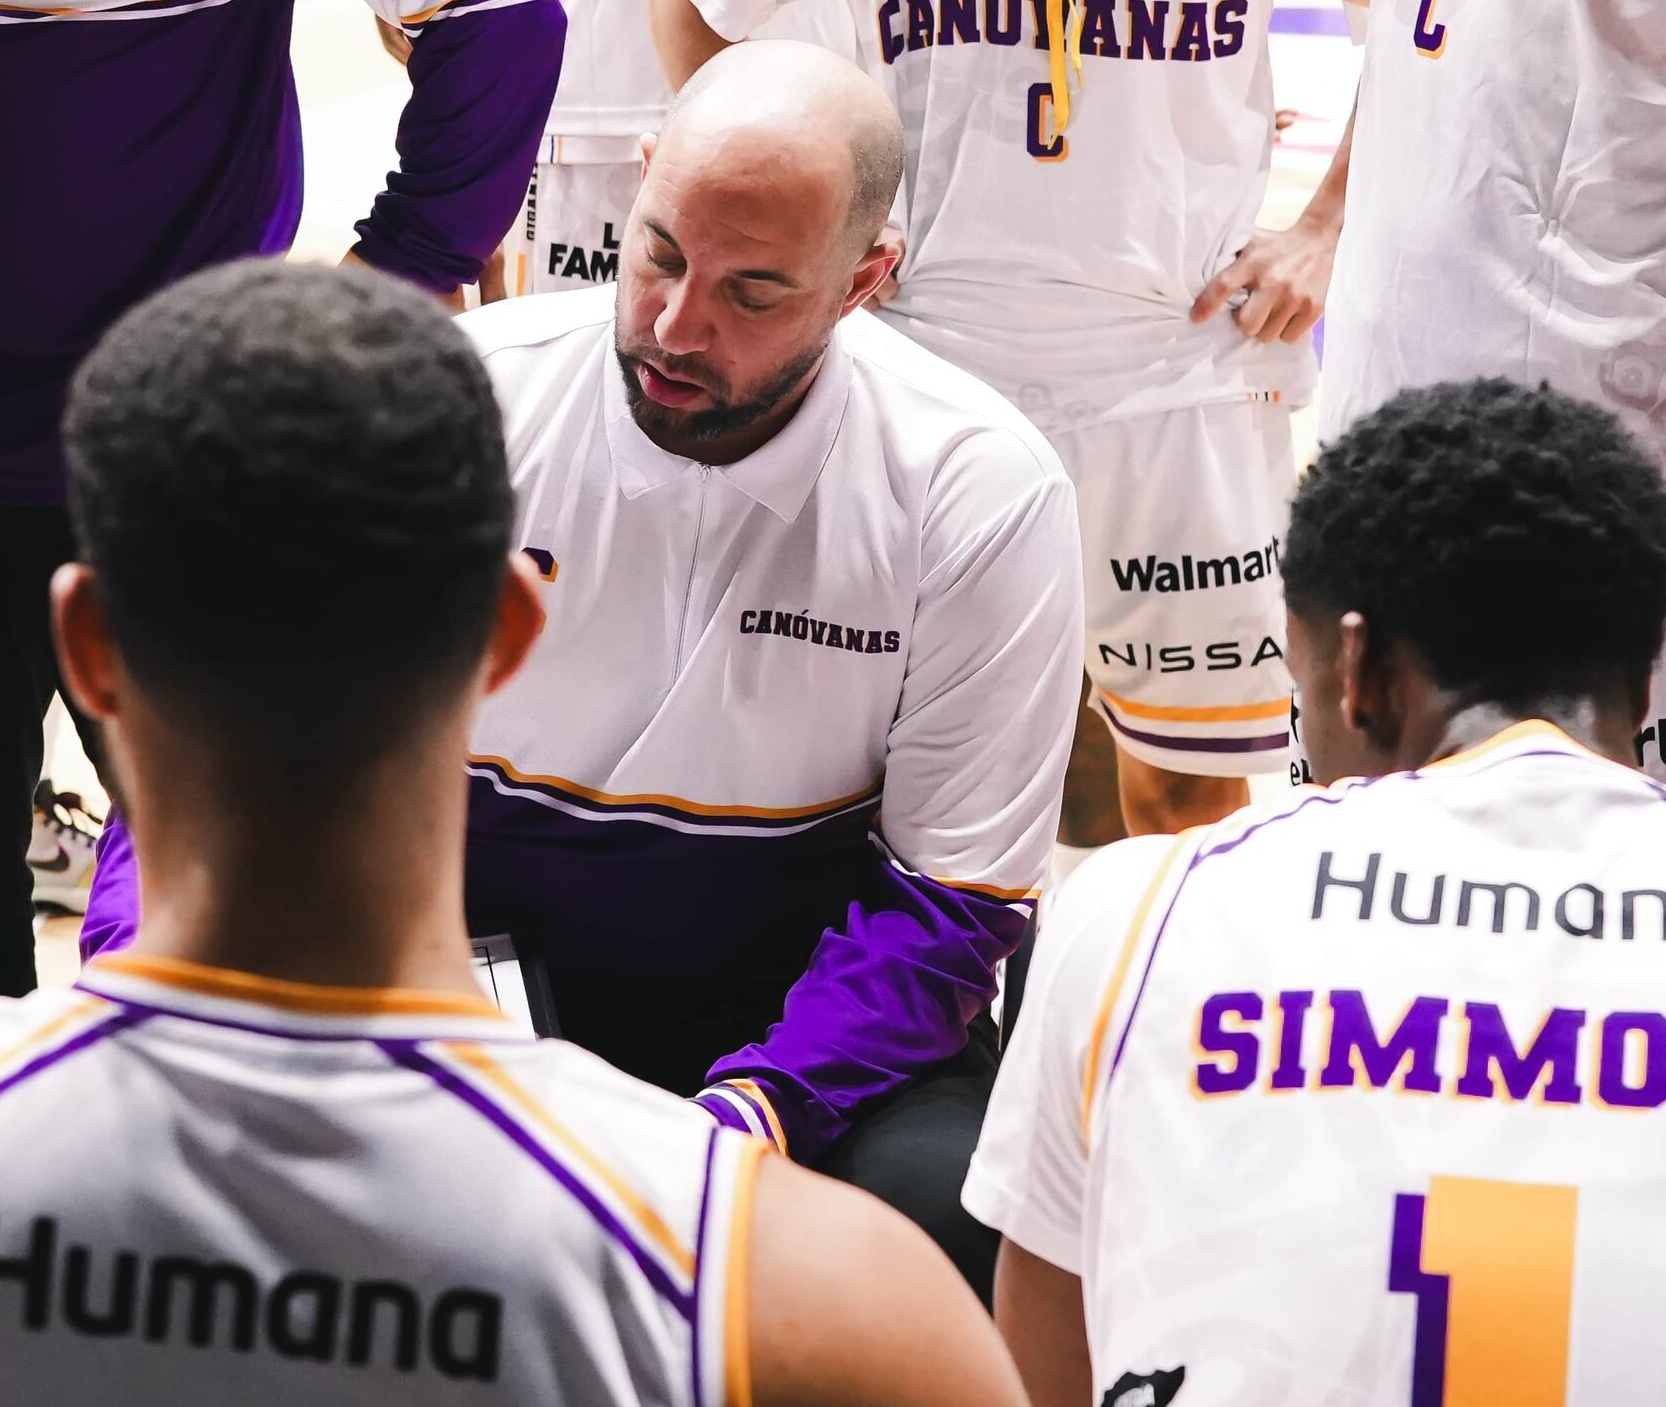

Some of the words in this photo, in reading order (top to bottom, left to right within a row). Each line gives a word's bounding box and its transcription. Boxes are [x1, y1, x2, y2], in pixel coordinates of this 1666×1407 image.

[1026, 81, 1069, 163] C
[739, 607, 901, 655] CANÓVANAS
[1098, 636, 1284, 674] NISSA
